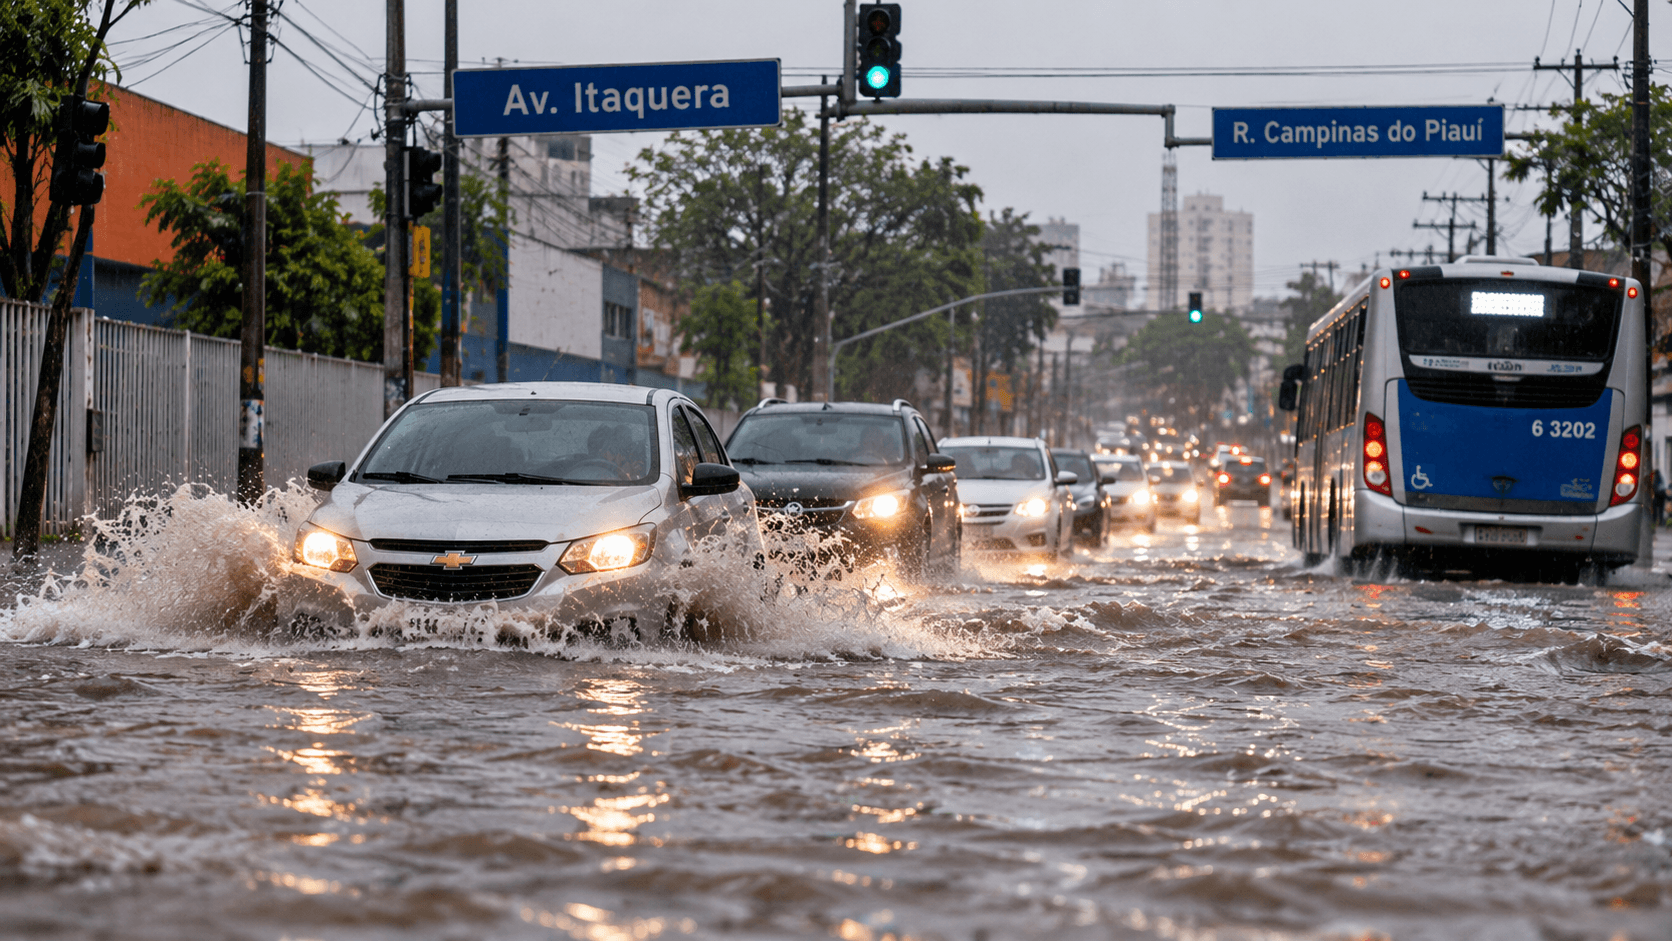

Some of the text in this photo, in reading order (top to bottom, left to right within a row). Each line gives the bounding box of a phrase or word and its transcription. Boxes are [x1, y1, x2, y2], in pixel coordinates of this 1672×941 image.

[503, 82, 730, 119] Av. Itaquera
[1233, 117, 1483, 148] R. Campinas do Piauí
[1531, 419, 1596, 439] 6 3202
